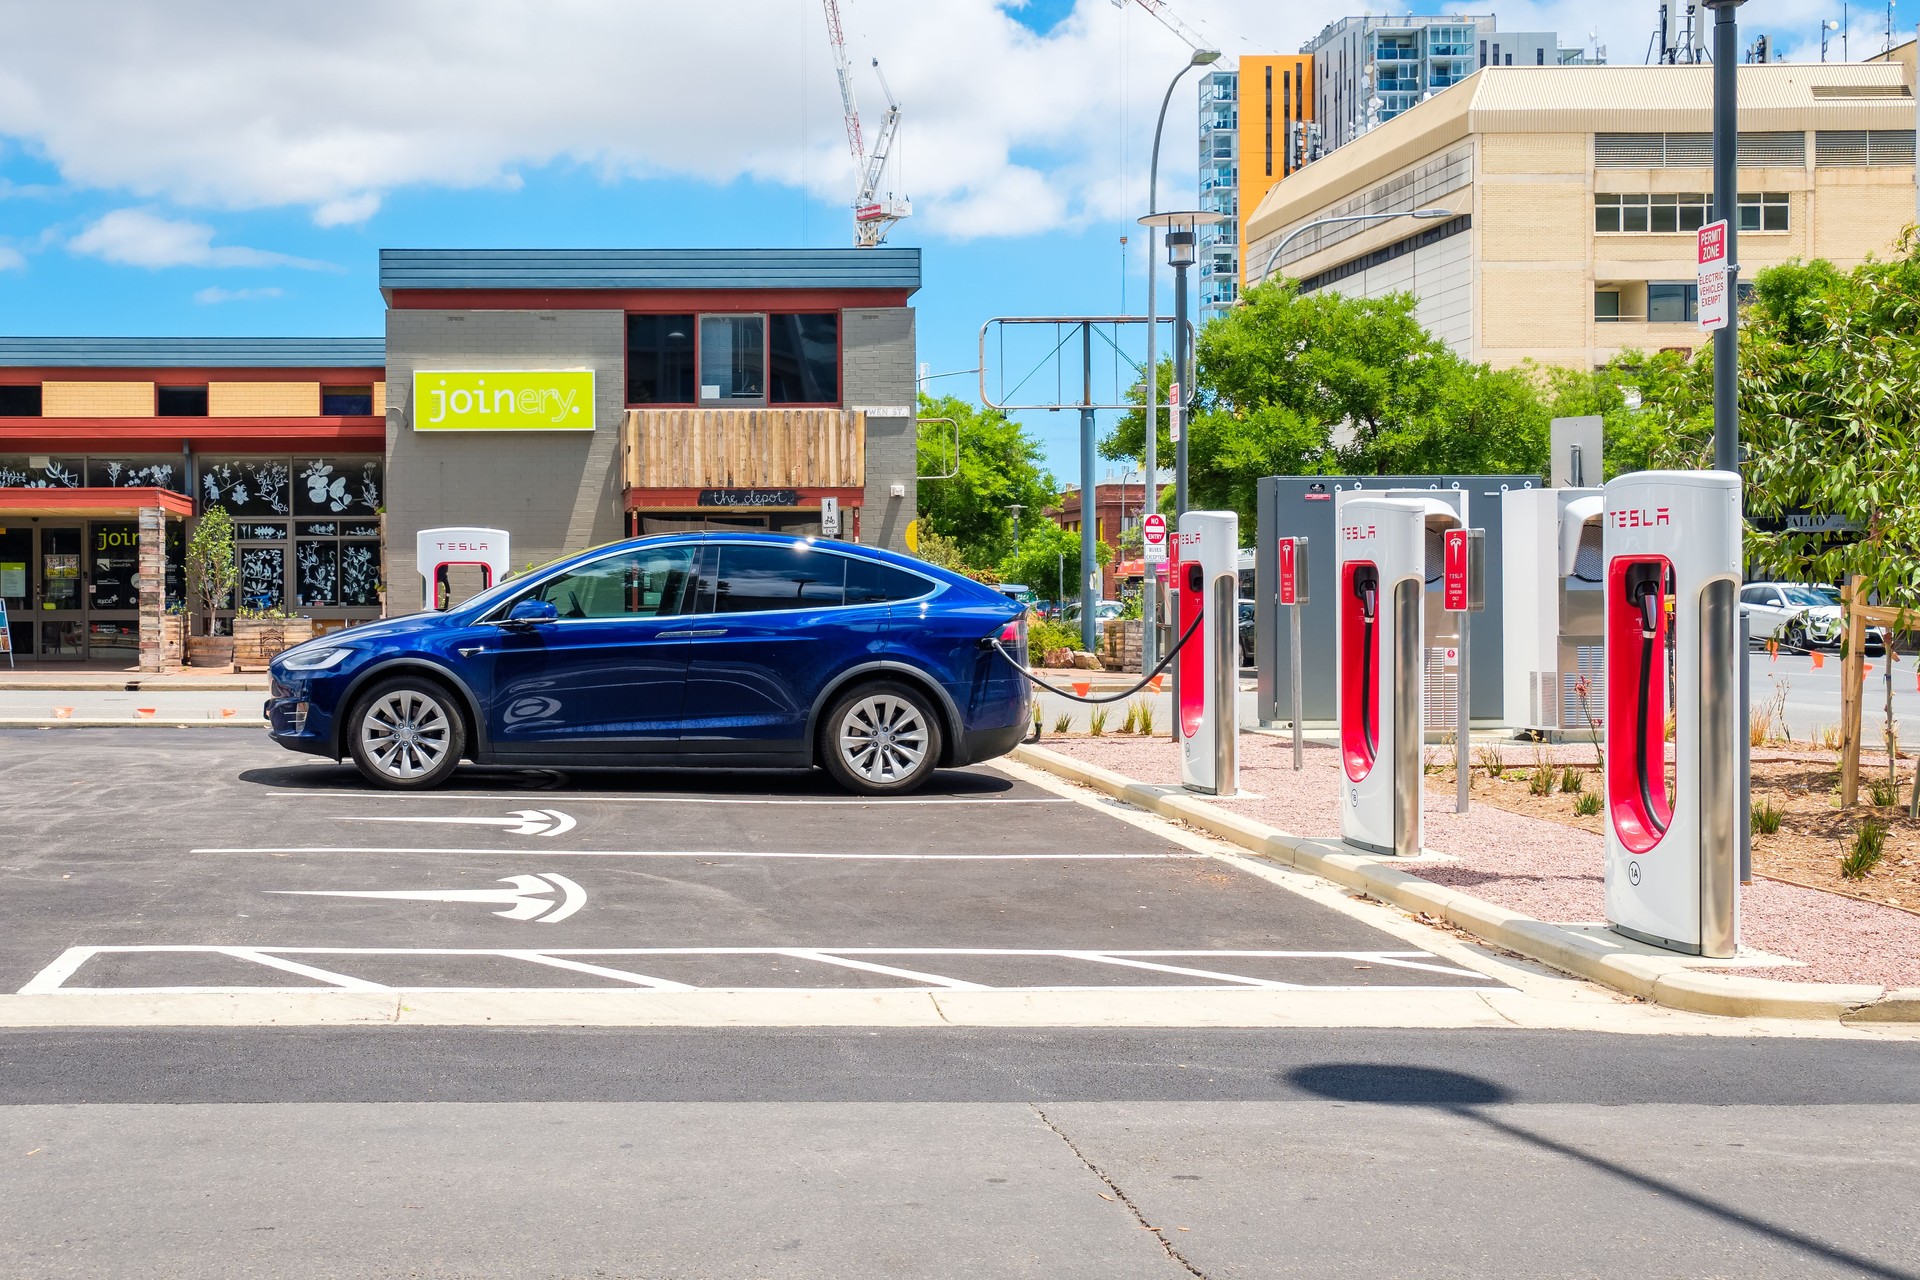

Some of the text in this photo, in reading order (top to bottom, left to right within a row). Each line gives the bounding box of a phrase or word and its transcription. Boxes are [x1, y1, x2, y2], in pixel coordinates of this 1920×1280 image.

[1700, 228, 1721, 246] PERMIT
[1702, 244, 1720, 260] ZONE
[1699, 271, 1723, 285] ELECTRIC
[1699, 282, 1724, 296] VEHICLES
[1701, 294, 1721, 307] EXEMPT
[429, 379, 580, 423] joinery.
[866, 408, 888, 416] WEN
[713, 490, 788, 506] the depot
[1609, 508, 1669, 528] TESLA
[1342, 525, 1375, 540] TESLA
[436, 542, 488, 551] TESLA
[1631, 868, 1638, 878] 1A
